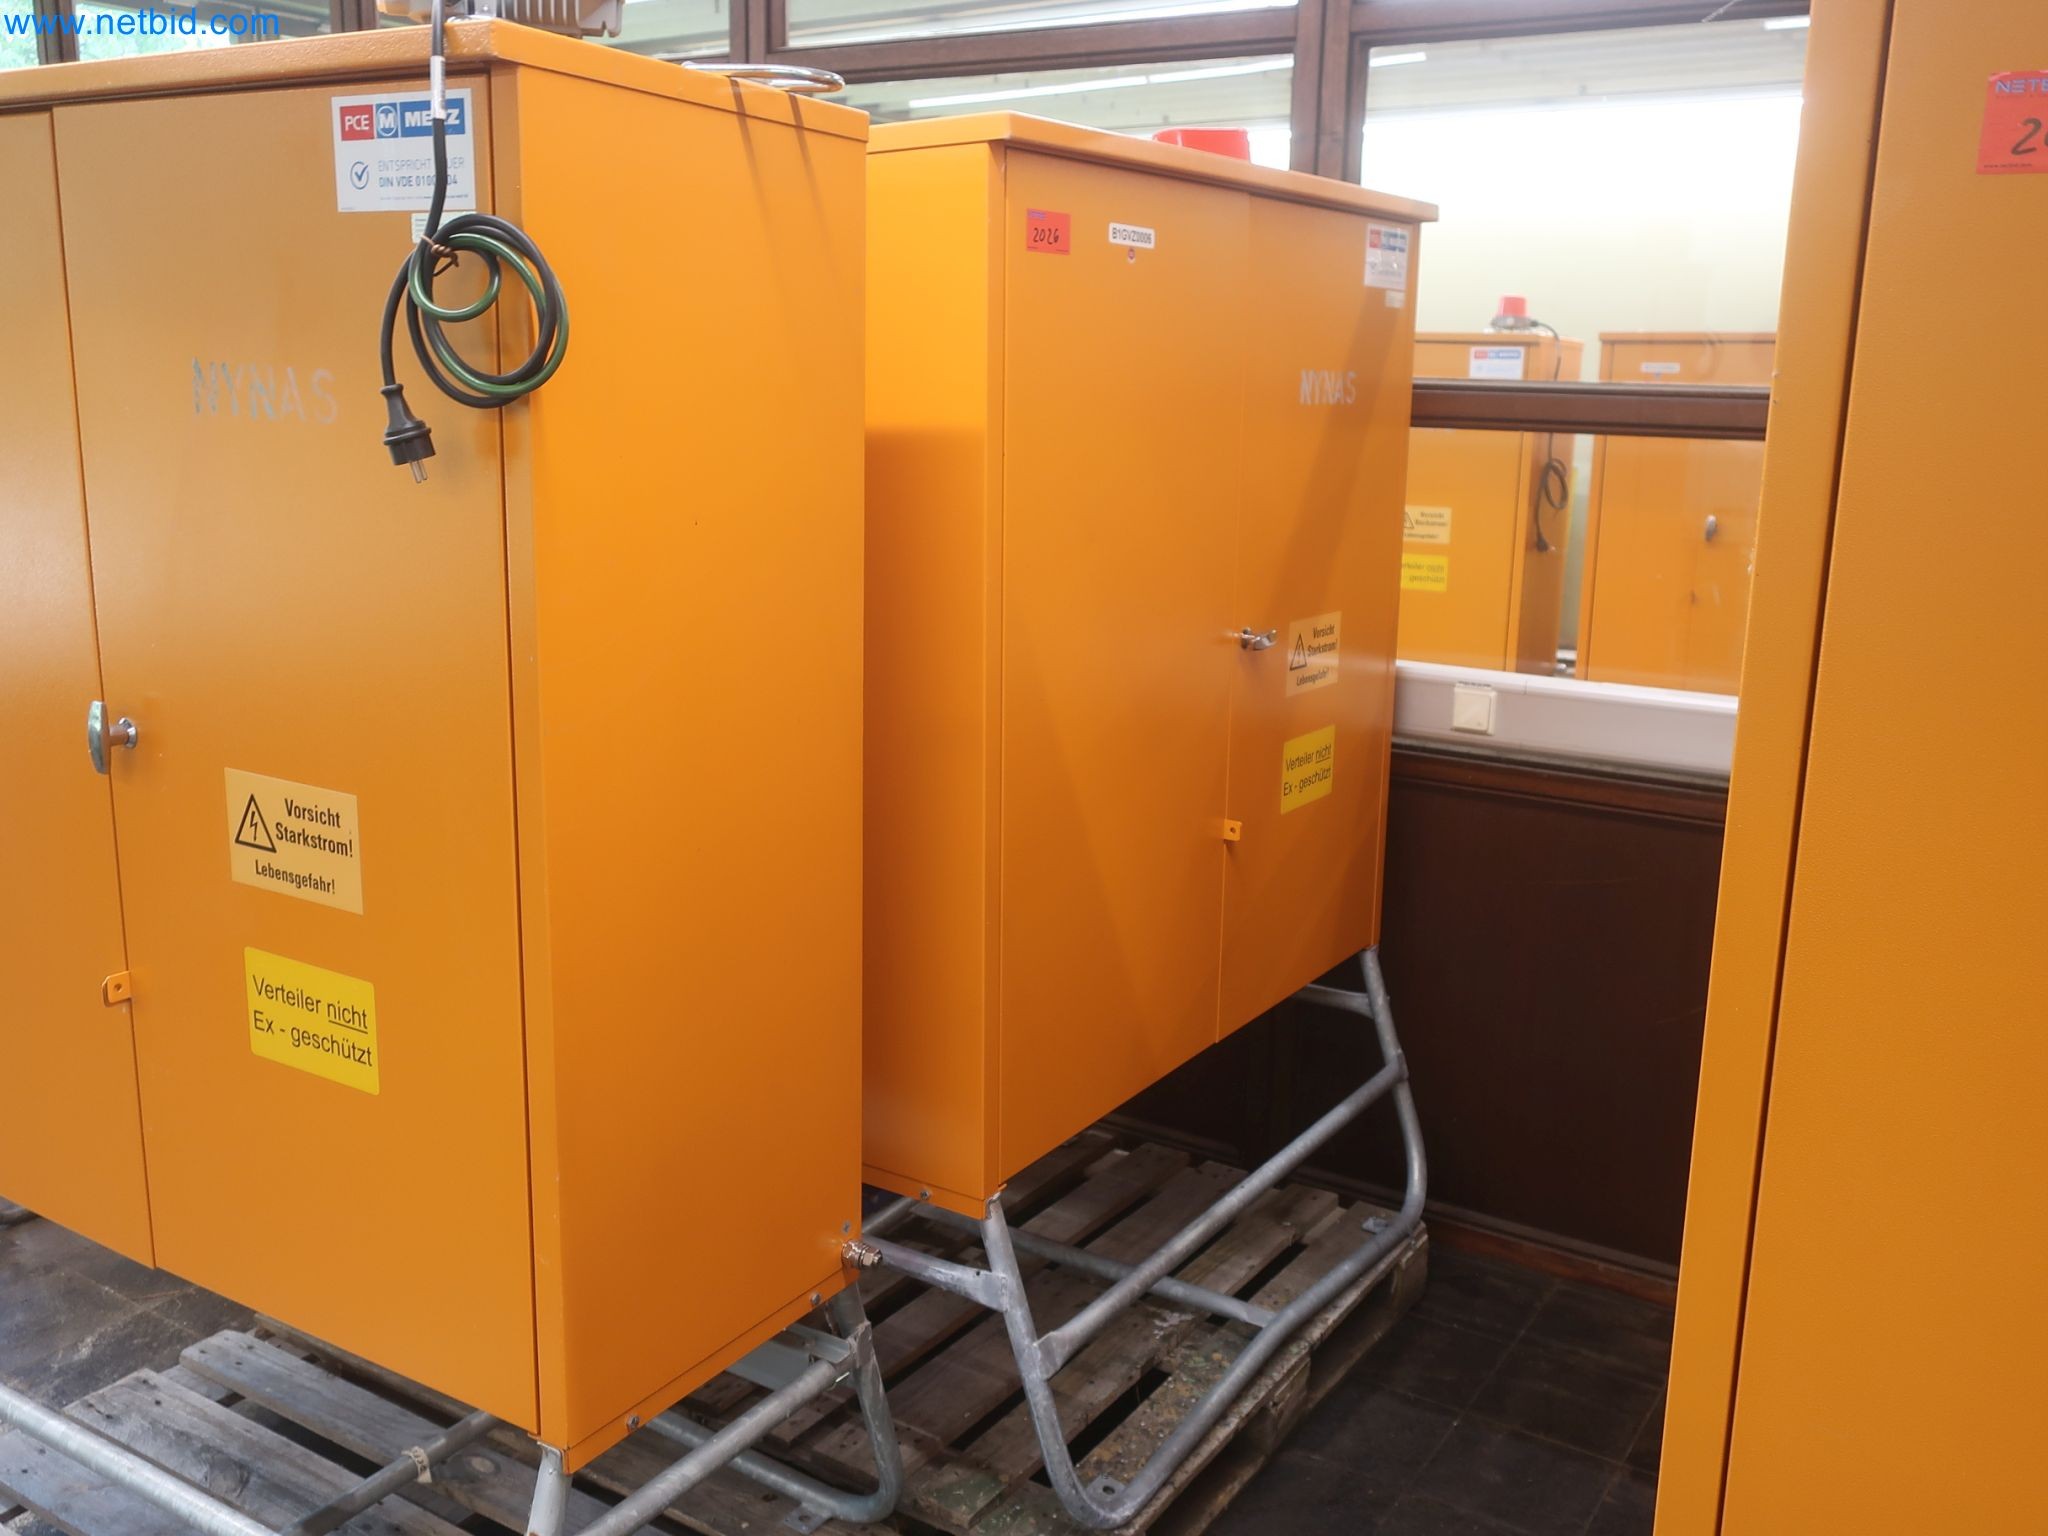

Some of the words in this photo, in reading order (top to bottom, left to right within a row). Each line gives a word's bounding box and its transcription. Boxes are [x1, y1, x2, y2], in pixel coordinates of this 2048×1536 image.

[344, 115, 370, 131] PCE
[405, 108, 460, 128] MEZ
[2011, 117, 2048, 155] 2
[377, 158, 432, 172] ENTSPRICHT
[379, 176, 393, 188] DIN
[395, 176, 414, 188] VDE
[1033, 227, 1060, 245] 2026
[191, 356, 339, 425] NYNAS
[1299, 367, 1358, 405] NYNAS
[1313, 624, 1335, 639] Vorsicht
[1285, 752, 1314, 772] Verteiler
[1315, 744, 1332, 762] nicht
[1283, 782, 1293, 797] Ex
[1299, 767, 1331, 793] geschützt
[284, 798, 341, 828] Vorsicht
[275, 822, 353, 858] Starkstrom!
[255, 859, 336, 894] Lebensgefahr!
[253, 974, 322, 1014] Verteiler
[327, 1001, 368, 1031] nicht
[253, 1009, 275, 1035] Ex
[290, 1026, 373, 1067] geschützt
